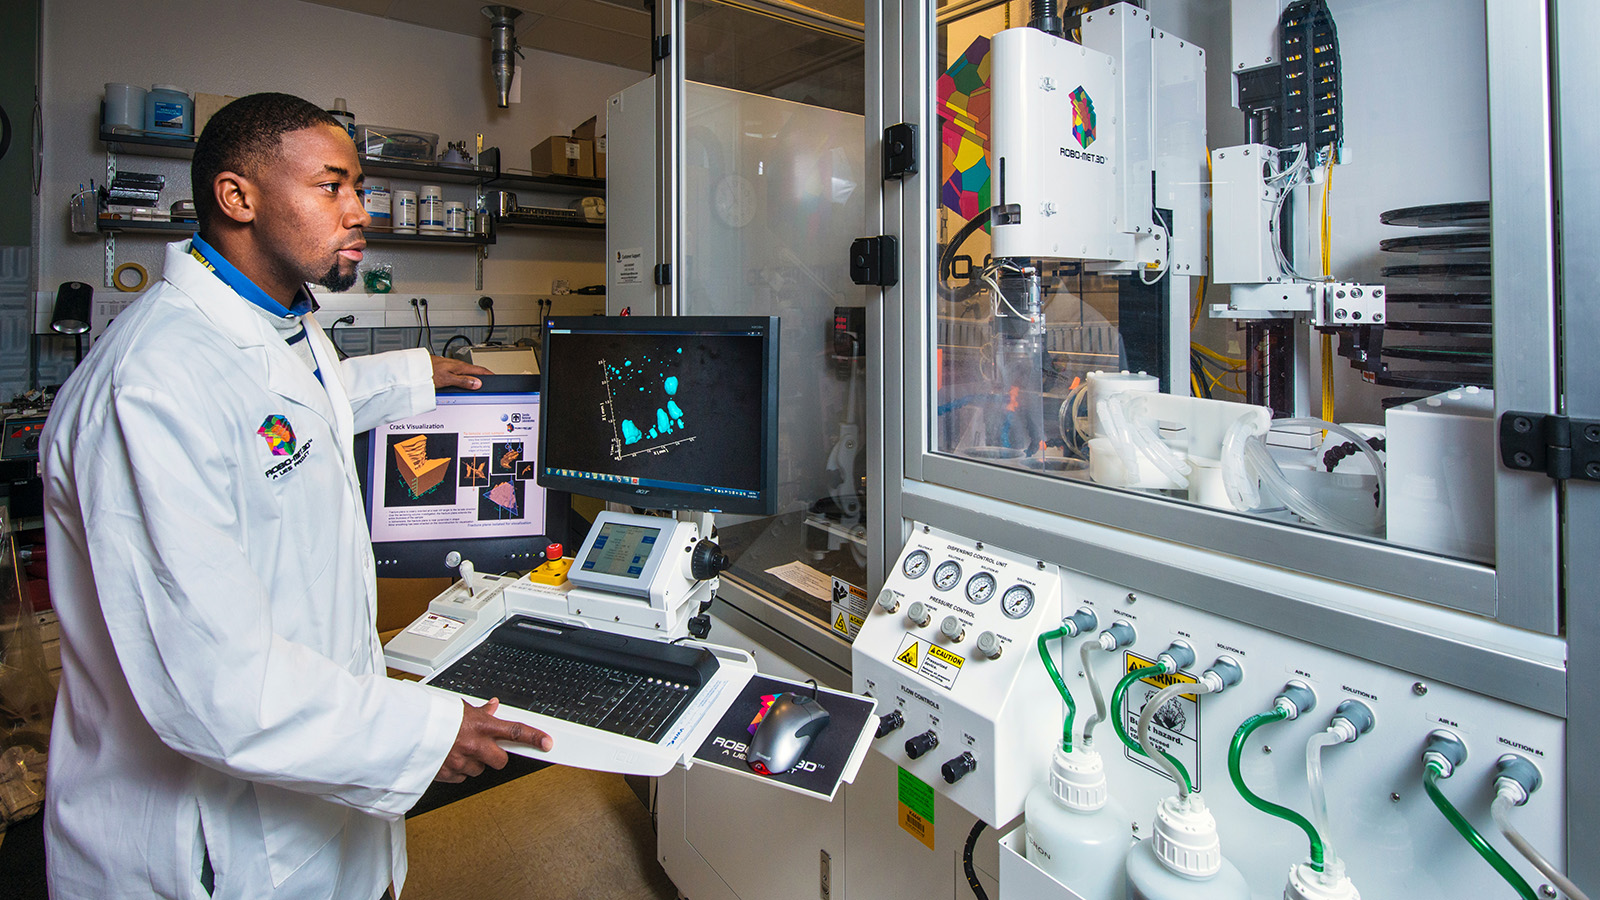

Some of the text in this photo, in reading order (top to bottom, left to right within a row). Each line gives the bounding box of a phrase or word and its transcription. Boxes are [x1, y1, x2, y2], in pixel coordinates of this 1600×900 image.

[947, 544, 1008, 568] DISPENSING CONTROL UNIT
[929, 595, 975, 618] PRESSURE CONTROL
[1113, 609, 1132, 618] SOLUTION
[935, 649, 963, 665] CAUTION
[1216, 643, 1239, 654] SOLUTION
[901, 684, 940, 710] FLOW CONTROLS
[1342, 685, 1378, 701] SOLUTION #3
[1438, 717, 1450, 725] AIR
[1152, 726, 1183, 746] hazard.
[1498, 736, 1544, 757] SOLUTION #4
